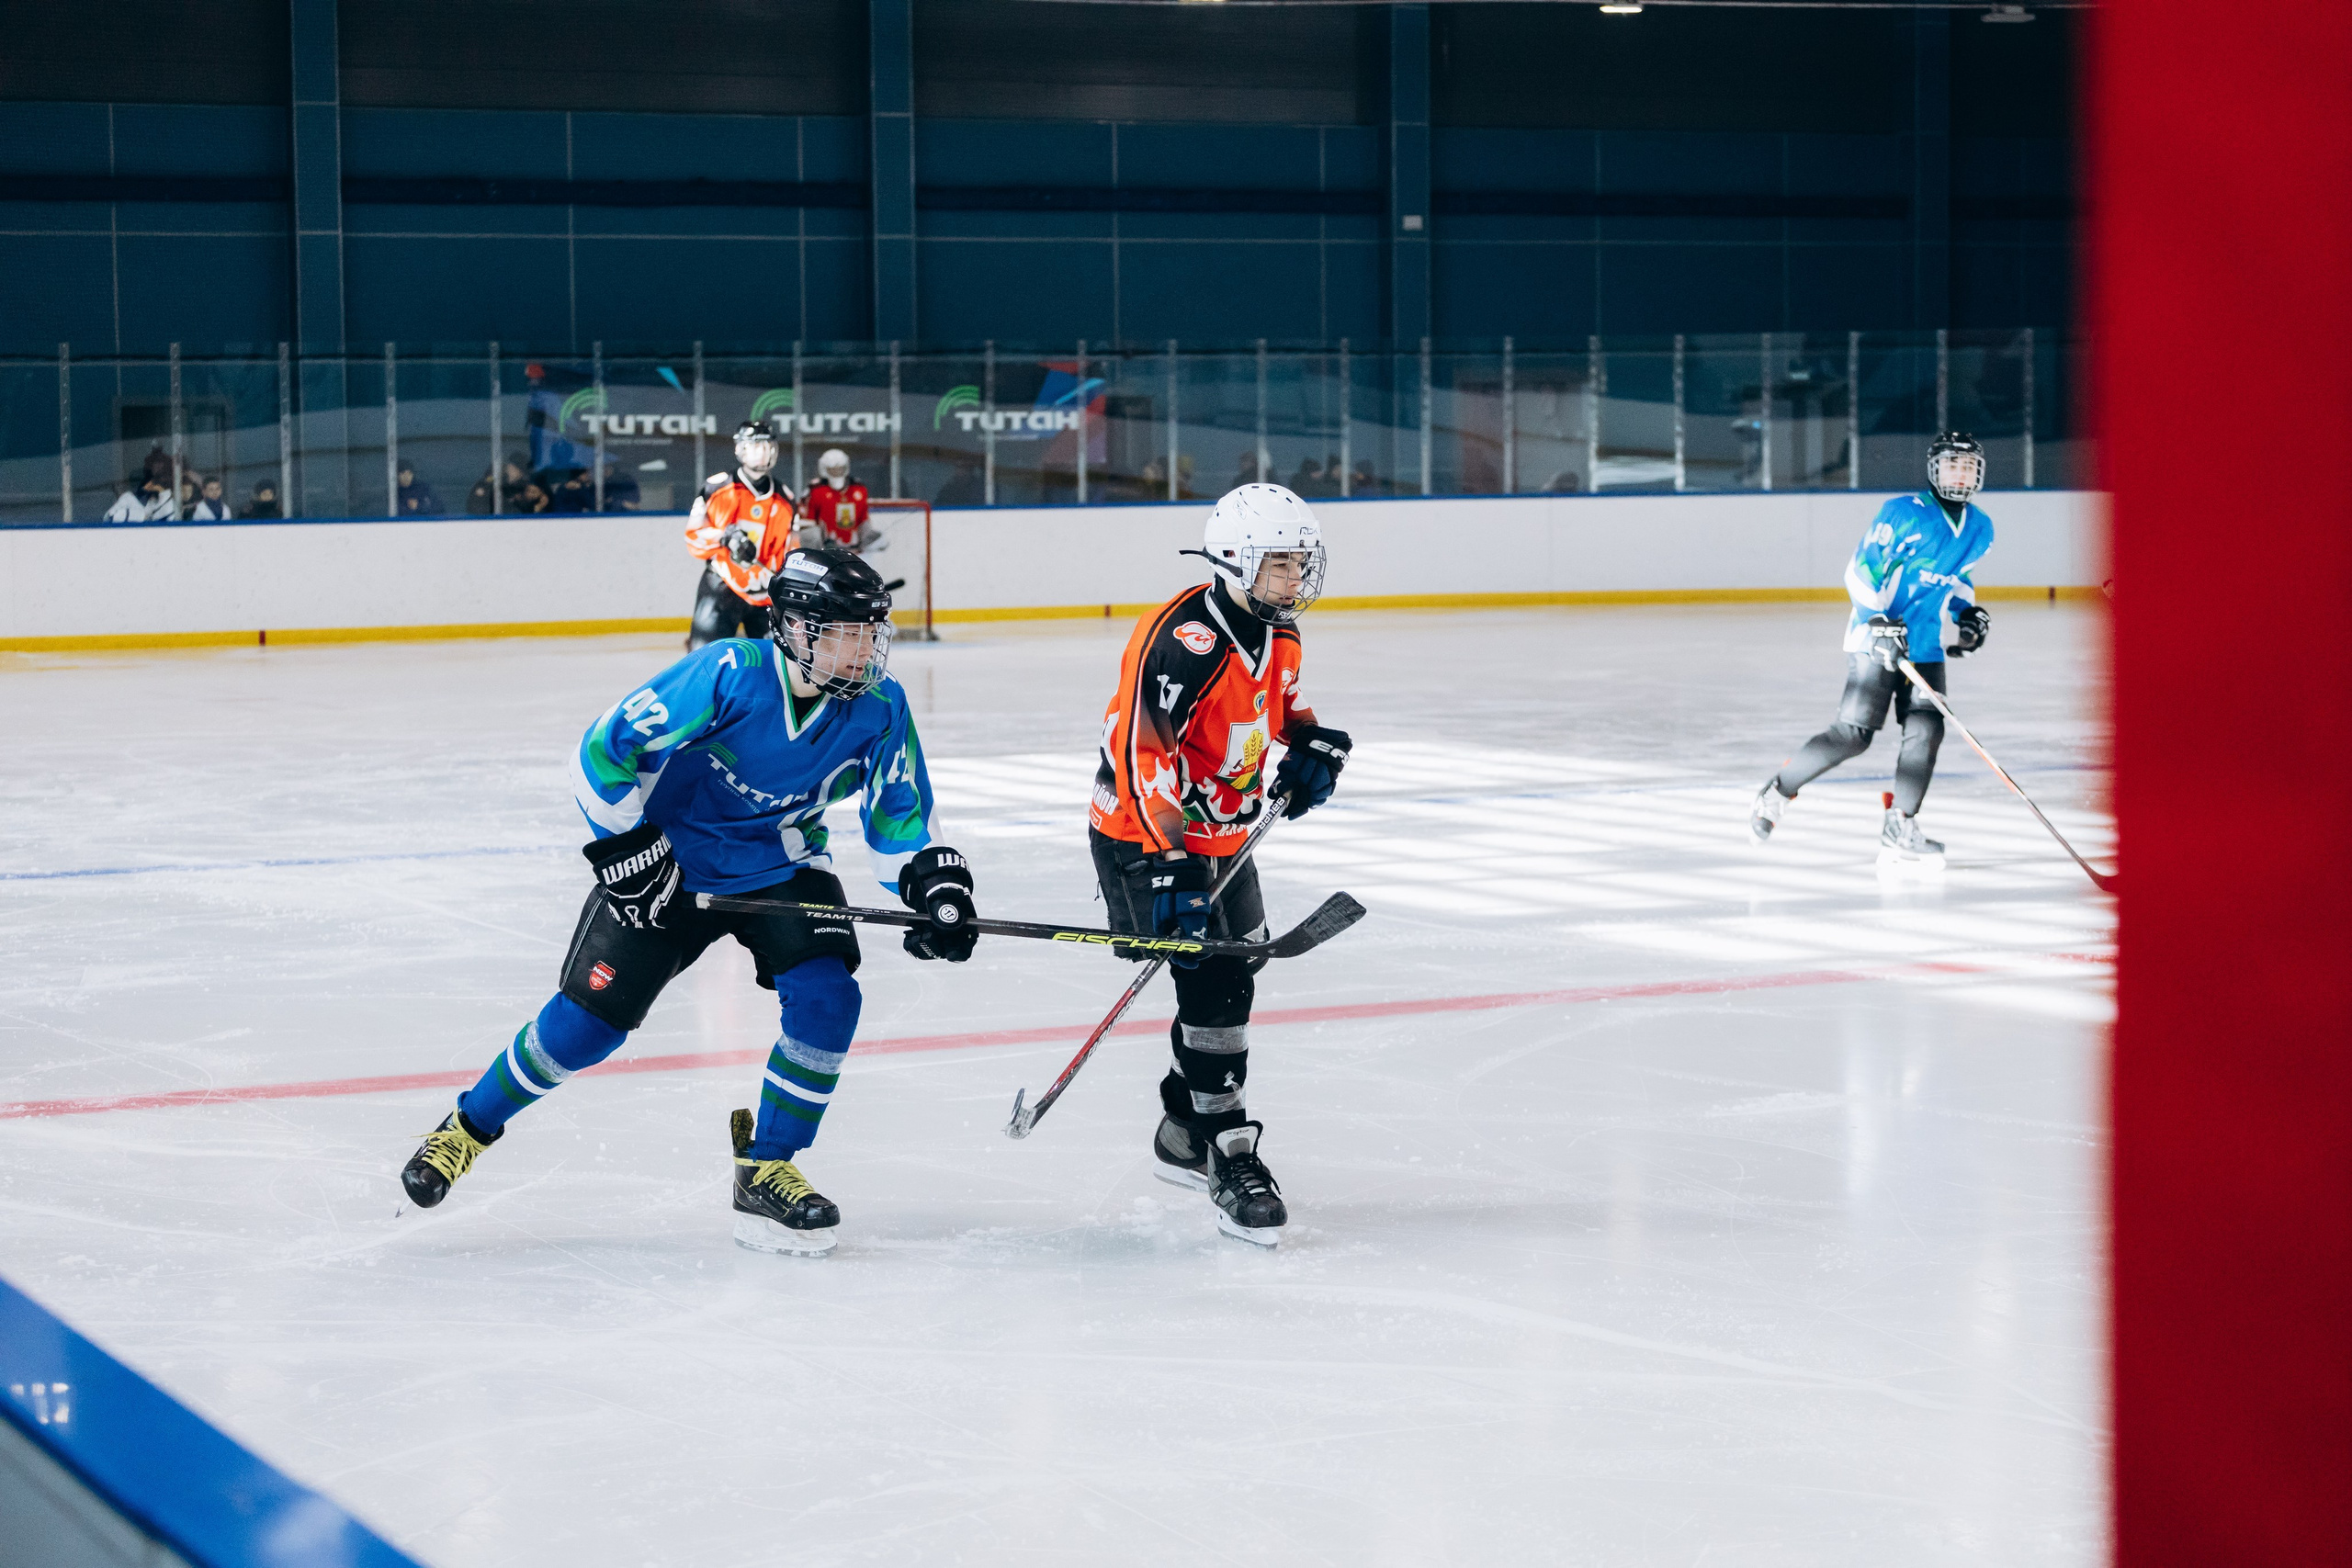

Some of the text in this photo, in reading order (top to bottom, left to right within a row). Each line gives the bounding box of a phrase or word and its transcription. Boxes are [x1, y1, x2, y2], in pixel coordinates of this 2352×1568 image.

[621, 687, 670, 737] 42
[806, 910, 865, 922] TEAM19
[814, 927, 851, 935] NORDWAY
[1051, 931, 1204, 953] FISCHER
